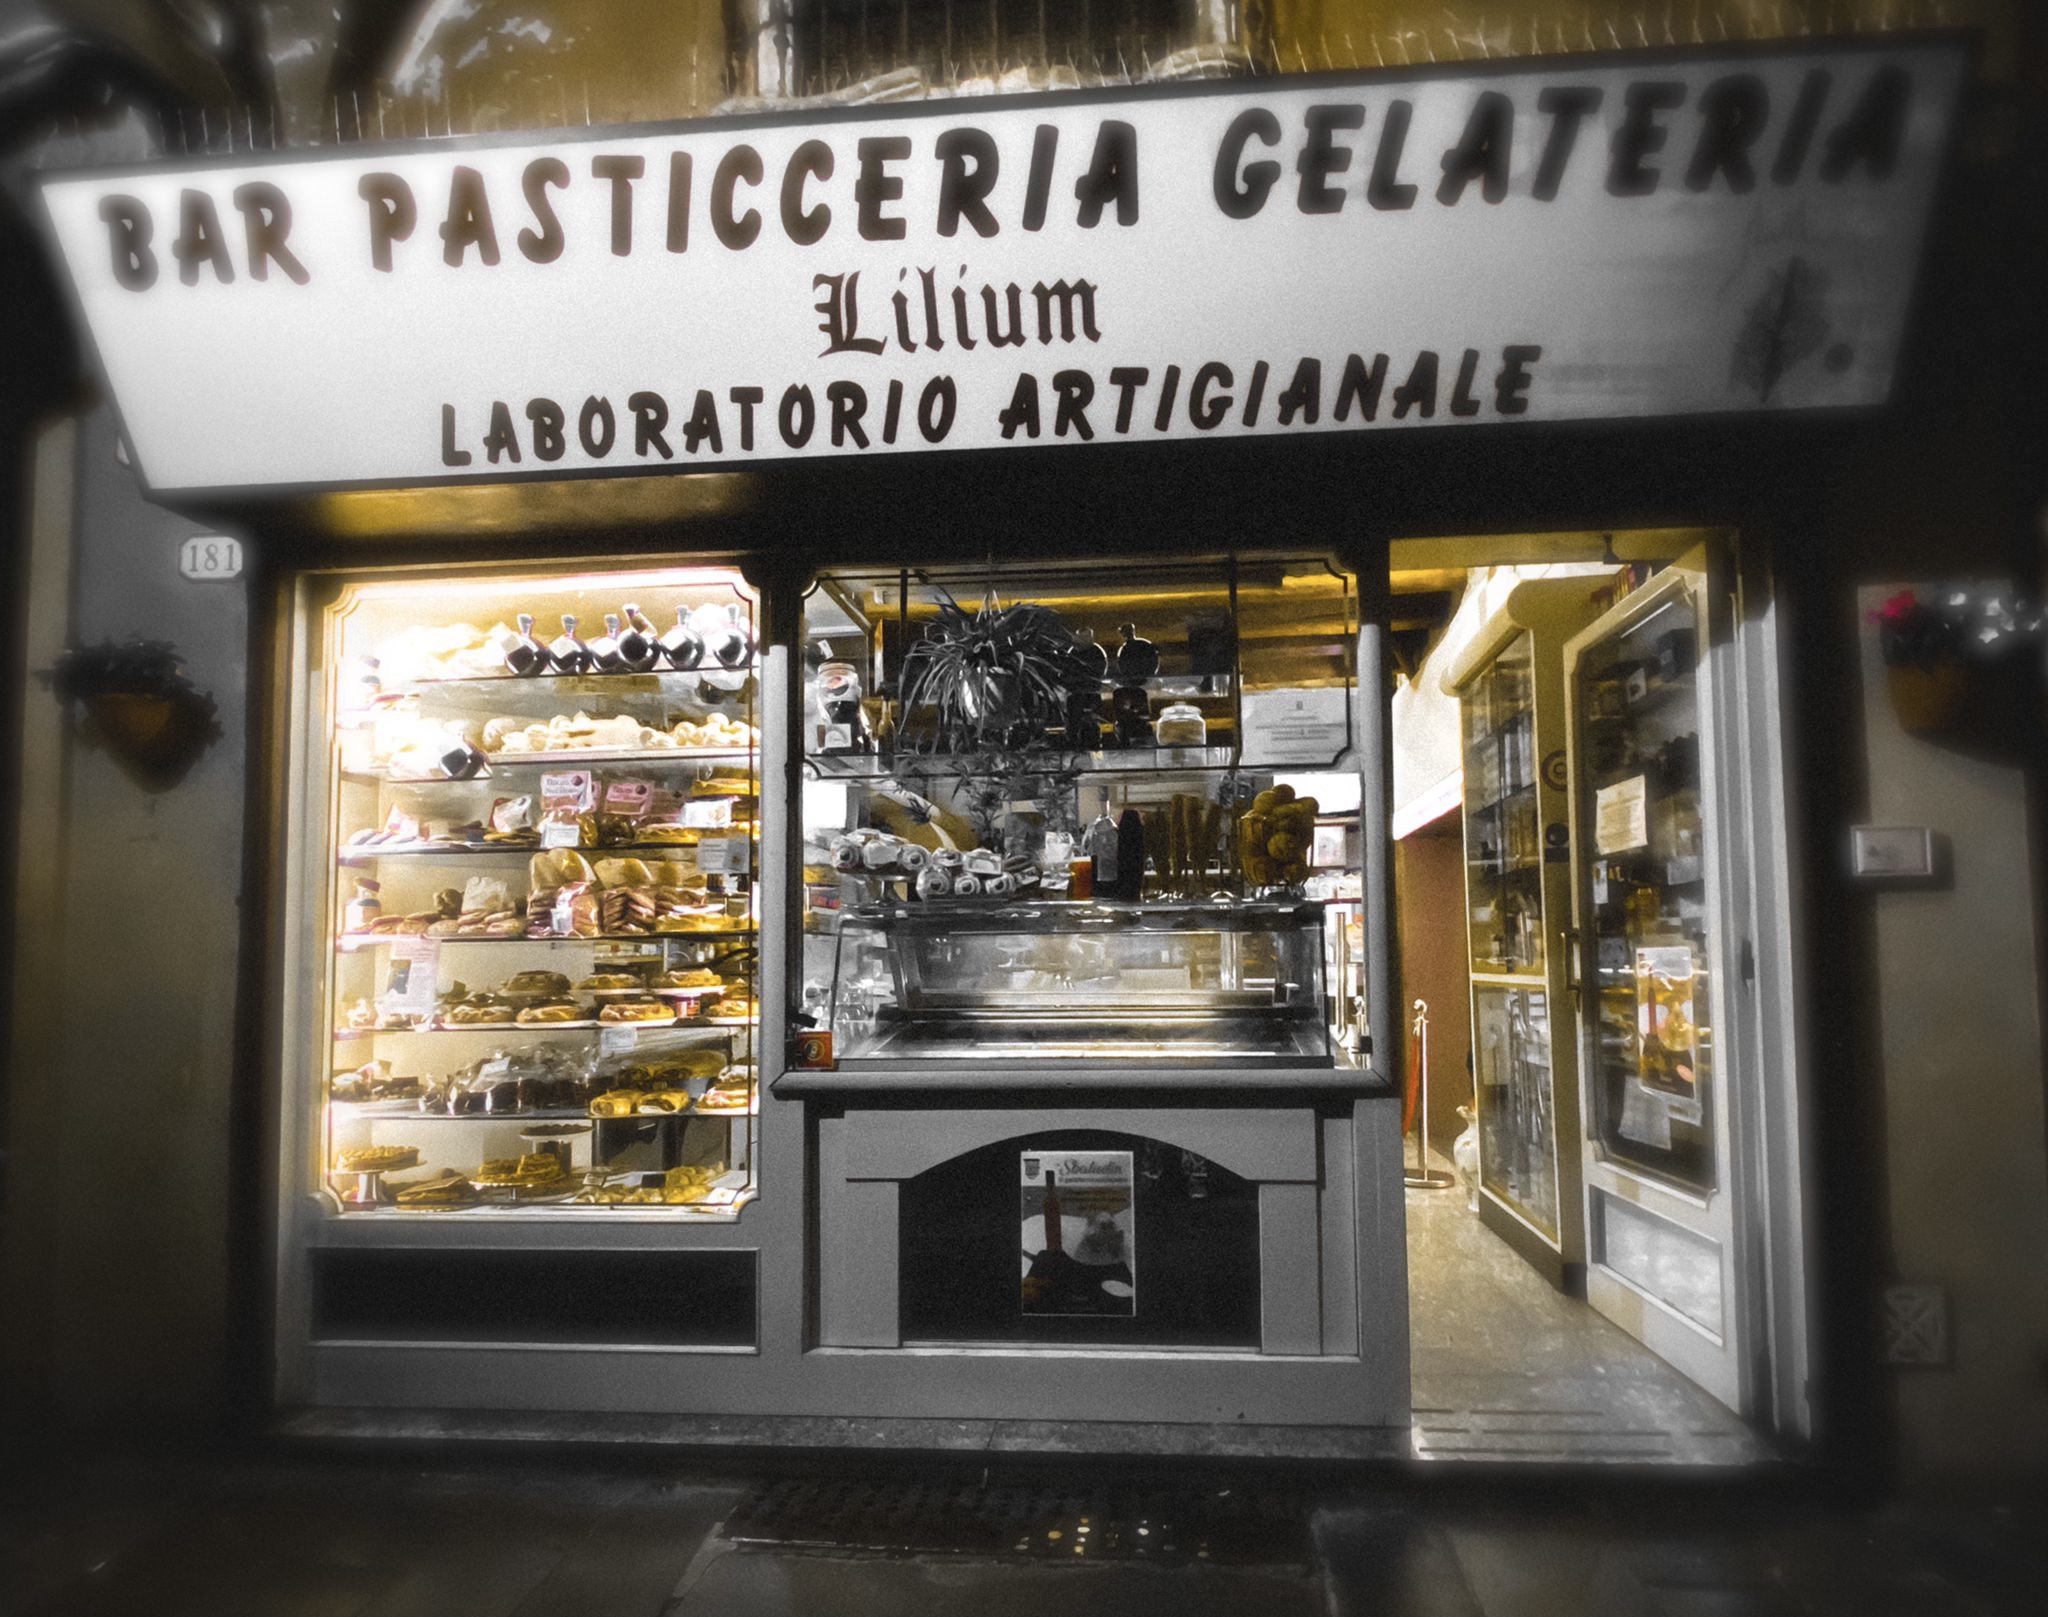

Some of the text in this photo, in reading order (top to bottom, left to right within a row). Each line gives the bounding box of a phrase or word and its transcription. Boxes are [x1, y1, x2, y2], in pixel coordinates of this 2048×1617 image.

[100, 64, 1912, 292] BAR PASTICCERIA GELATERIA
[812, 263, 1102, 358] Lilium
[440, 345, 1542, 468] LABORATORIO ARTIGIANALE
[188, 543, 235, 573] 181
